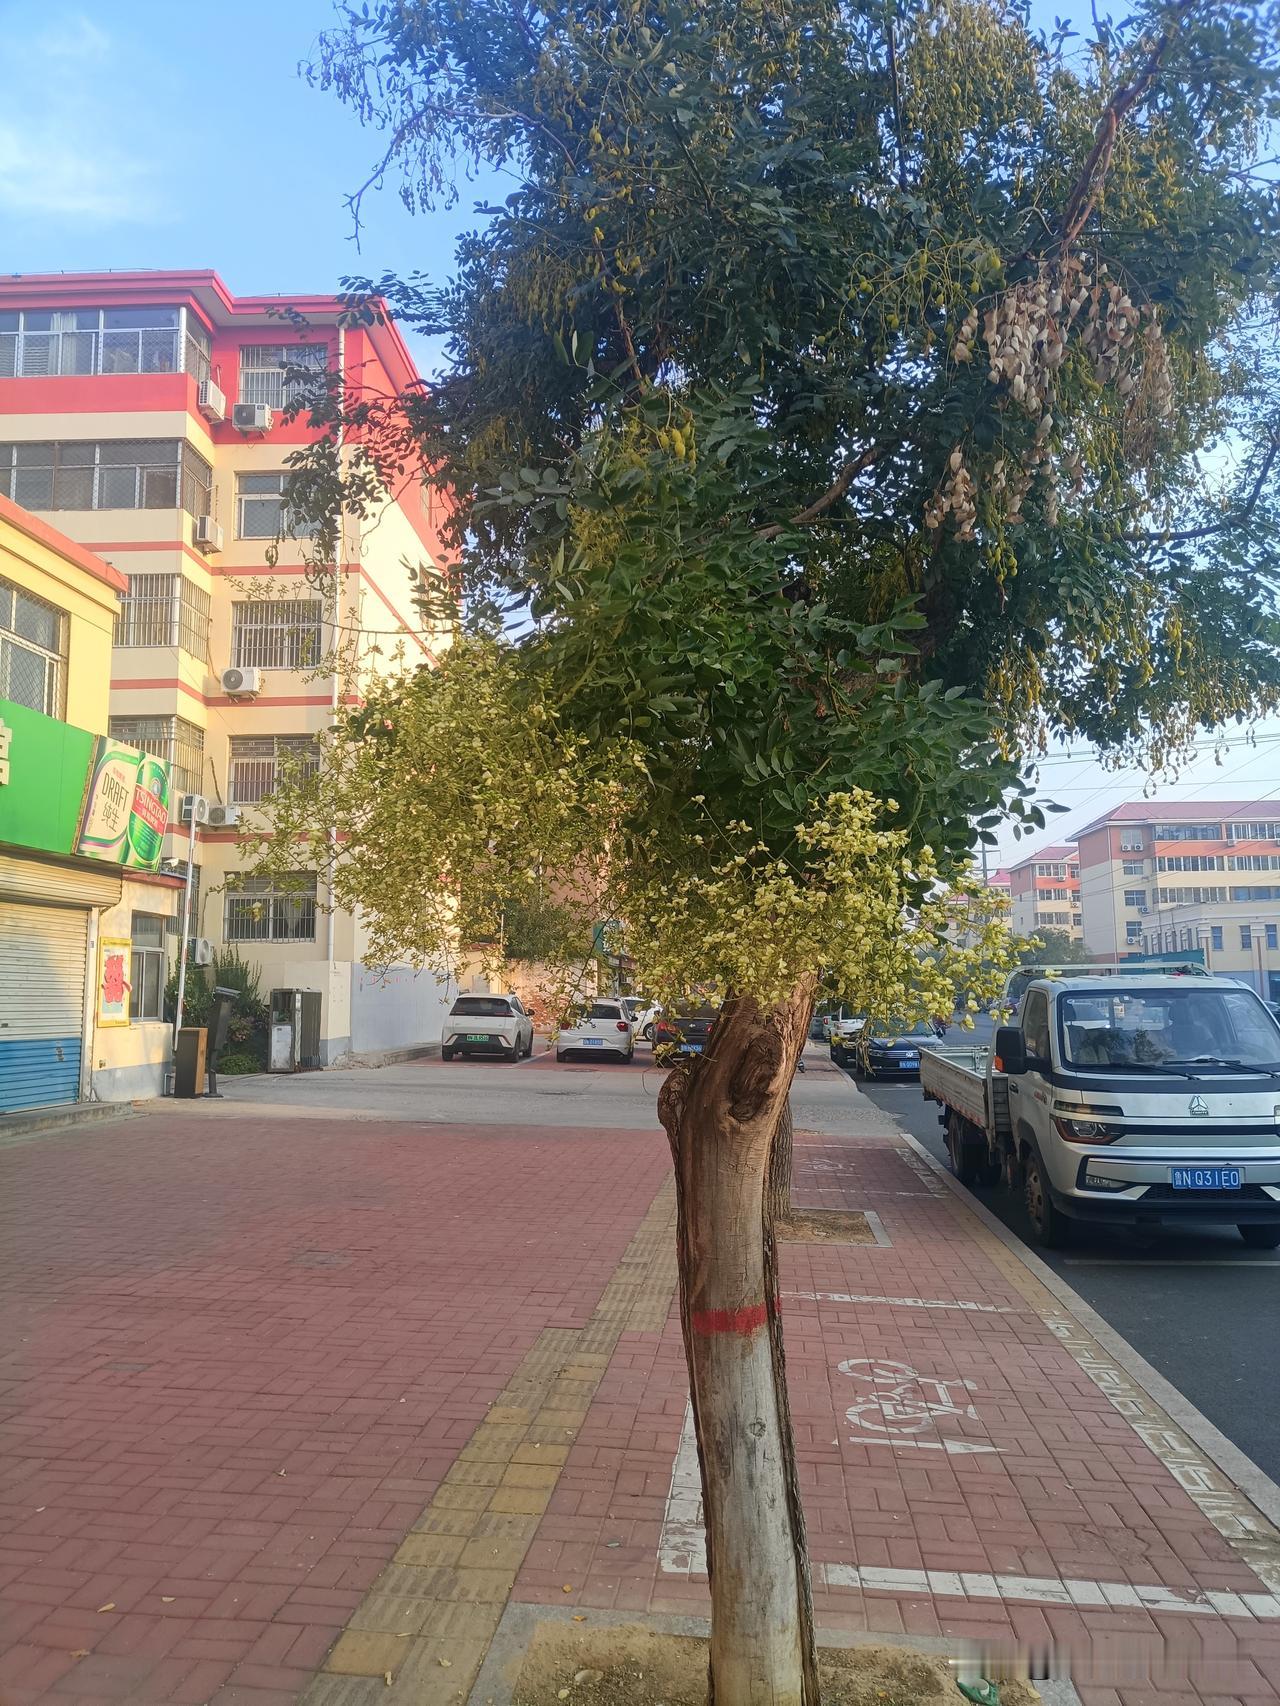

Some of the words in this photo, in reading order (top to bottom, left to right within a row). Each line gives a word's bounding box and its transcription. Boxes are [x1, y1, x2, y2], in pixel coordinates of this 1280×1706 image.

[102, 772, 129, 812] DRAFT
[136, 788, 167, 824] TSINGTAO
[101, 801, 120, 832] 纯生
